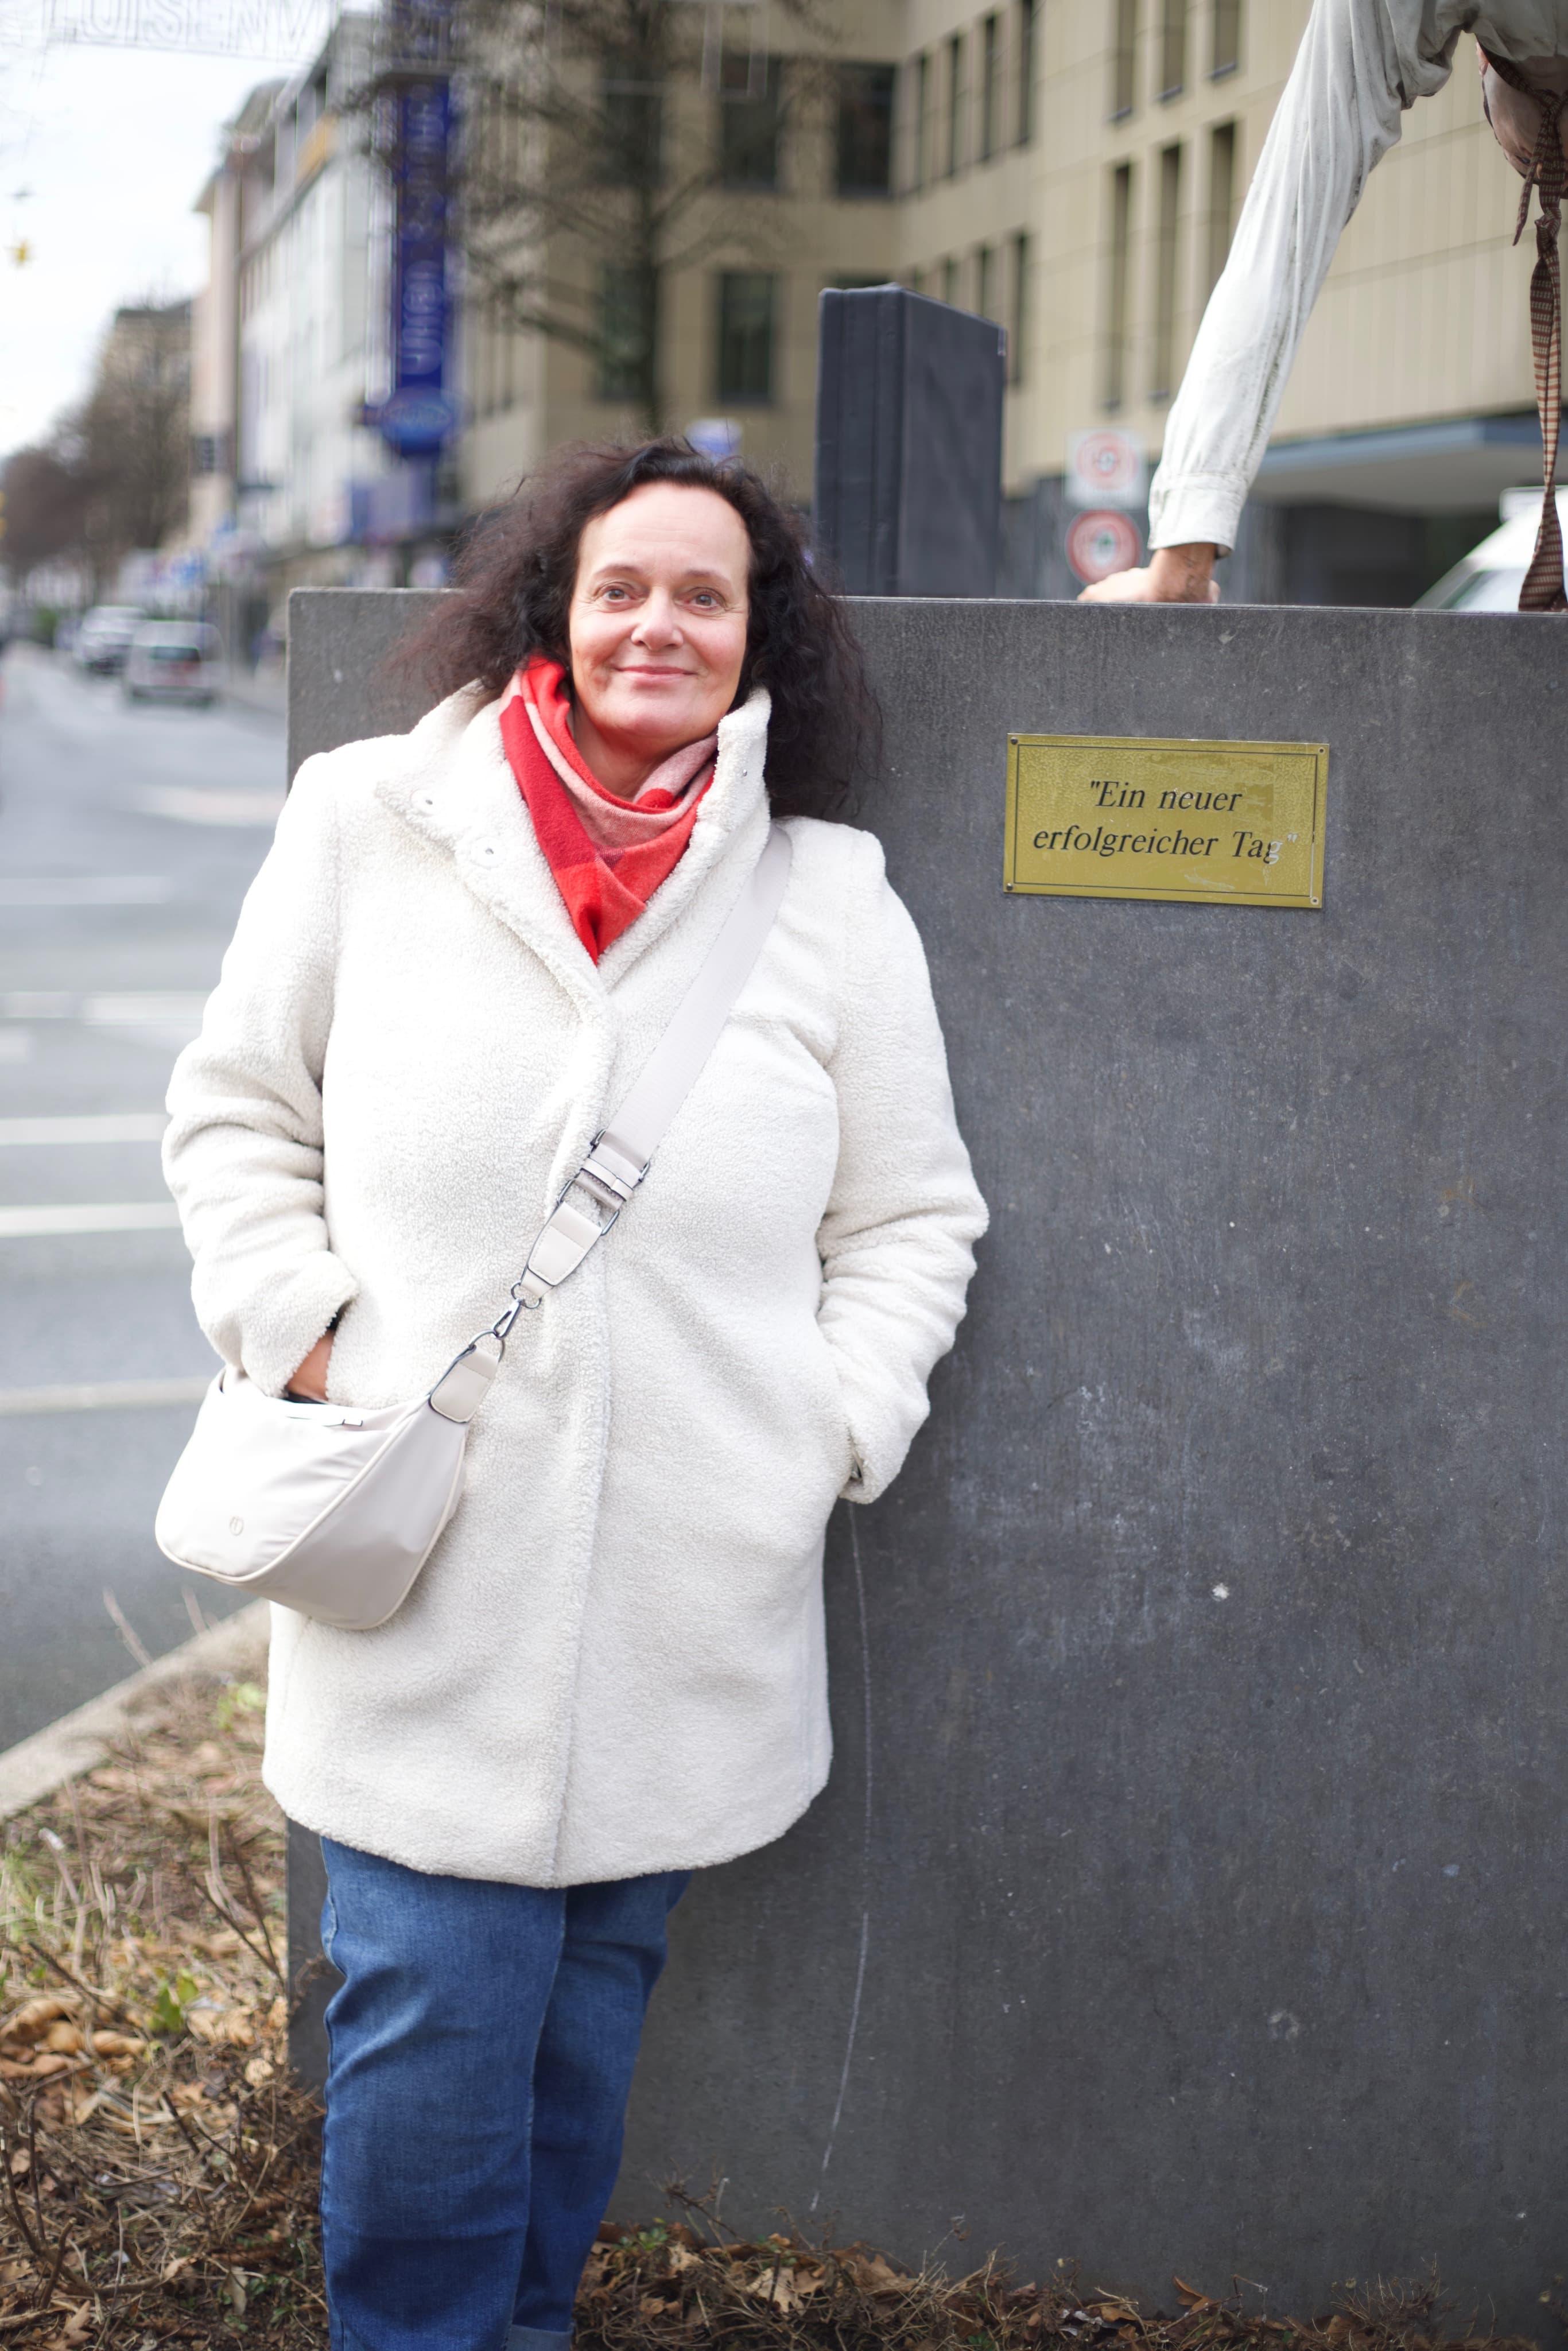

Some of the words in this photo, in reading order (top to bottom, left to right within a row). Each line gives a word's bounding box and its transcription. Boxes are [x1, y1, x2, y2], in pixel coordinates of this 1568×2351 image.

[1090, 779, 1146, 809] "Ein
[1156, 787, 1243, 812] neuer
[1033, 824, 1219, 858] erfolgreicher
[1232, 831, 1298, 865] Tag"
